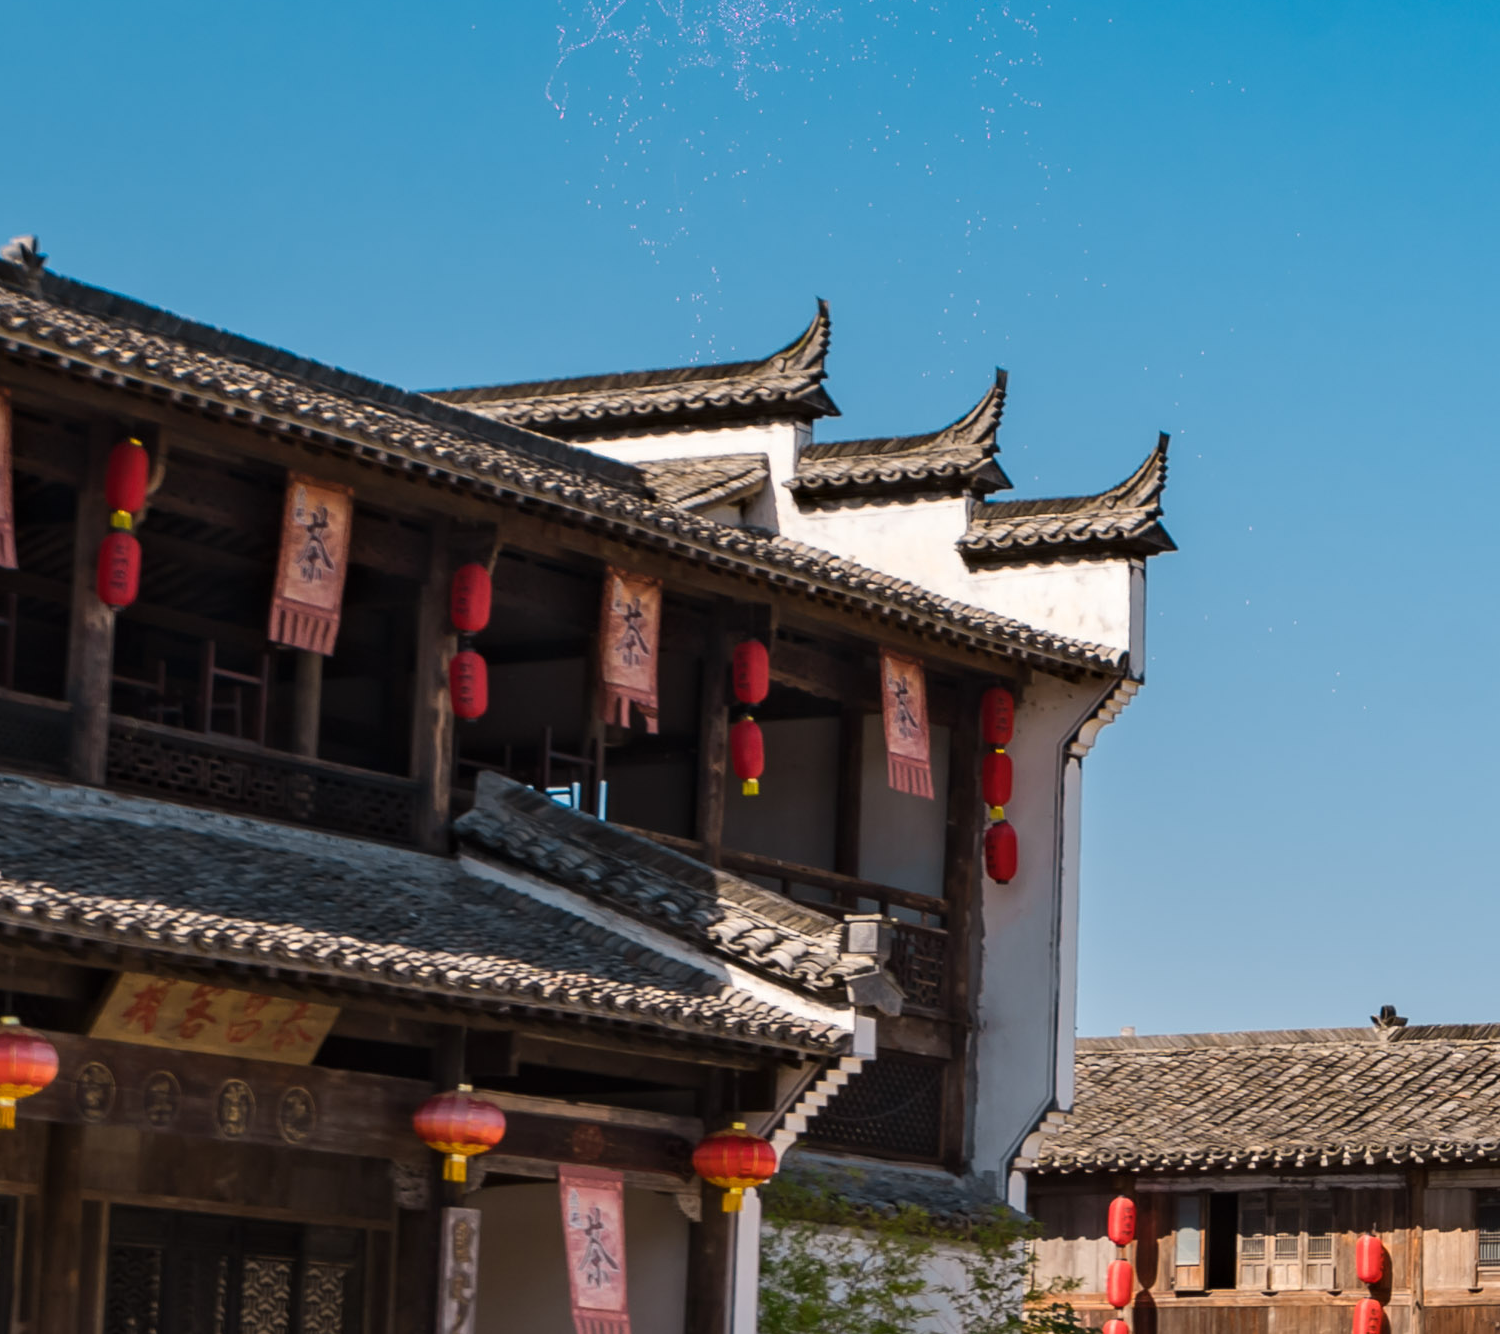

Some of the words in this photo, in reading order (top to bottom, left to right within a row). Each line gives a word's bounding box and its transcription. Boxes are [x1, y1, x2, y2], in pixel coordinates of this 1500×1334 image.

[295, 505, 335, 583] 茶
[615, 597, 650, 667] 茶
[893, 675, 920, 738] 茶
[578, 1206, 619, 1289] 茶
